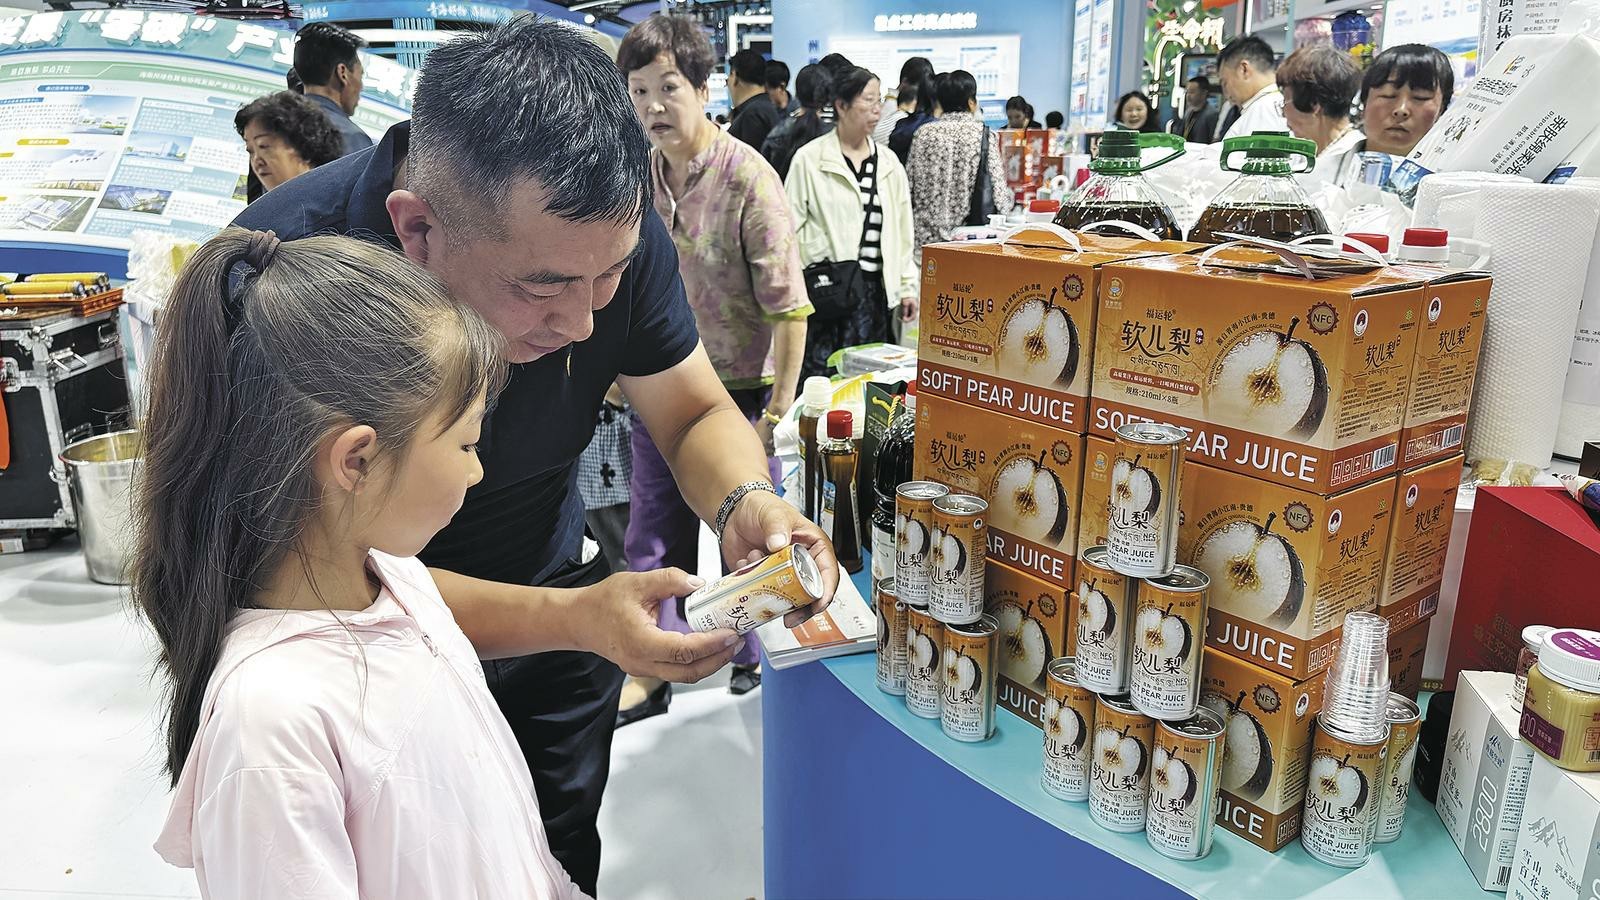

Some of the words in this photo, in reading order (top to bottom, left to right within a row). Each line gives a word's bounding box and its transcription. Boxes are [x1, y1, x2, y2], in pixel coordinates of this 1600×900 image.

[1502, 114, 1569, 176] 亲肤绵柔洗
[1065, 284, 1081, 294] NFC
[937, 292, 985, 323] 软儿梨
[1313, 313, 1332, 324] NFC
[1122, 320, 1191, 356] 软儿梨
[1438, 329, 1465, 352] 软儿梨
[1365, 342, 1397, 368] 软儿梨
[921, 368, 962, 395] SOFT
[967, 377, 1013, 408] PEAR
[1018, 391, 1075, 424] JUICE
[930, 438, 977, 471] 软儿梨
[1235, 442, 1317, 483] JUICE
[1289, 511, 1307, 524] NFC
[1415, 504, 1441, 530] 软儿梨
[896, 550, 922, 567] 儿梨
[1112, 543, 1129, 555] PEAR
[1131, 550, 1155, 558] JUICE
[1339, 533, 1369, 562] 软儿梨
[1010, 543, 1064, 580] JUICE
[1077, 623, 1105, 649] 儿梨
[1217, 623, 1296, 669] JUICE
[1090, 666, 1111, 676] JUICE
[919, 696, 936, 704] JUICE
[1141, 688, 1161, 700] PEAR
[1258, 692, 1276, 706] NFC
[960, 719, 979, 728] JUICE
[1045, 770, 1060, 782] PEAR
[1060, 777, 1082, 786] JUICE
[1100, 802, 1119, 816] PEAR
[1121, 808, 1142, 816] JUICE
[1306, 789, 1357, 823] 软儿梨
[1472, 775, 1498, 853] 2800
[1167, 833, 1190, 843] JUICE
[1313, 832, 1333, 846] PEAR
